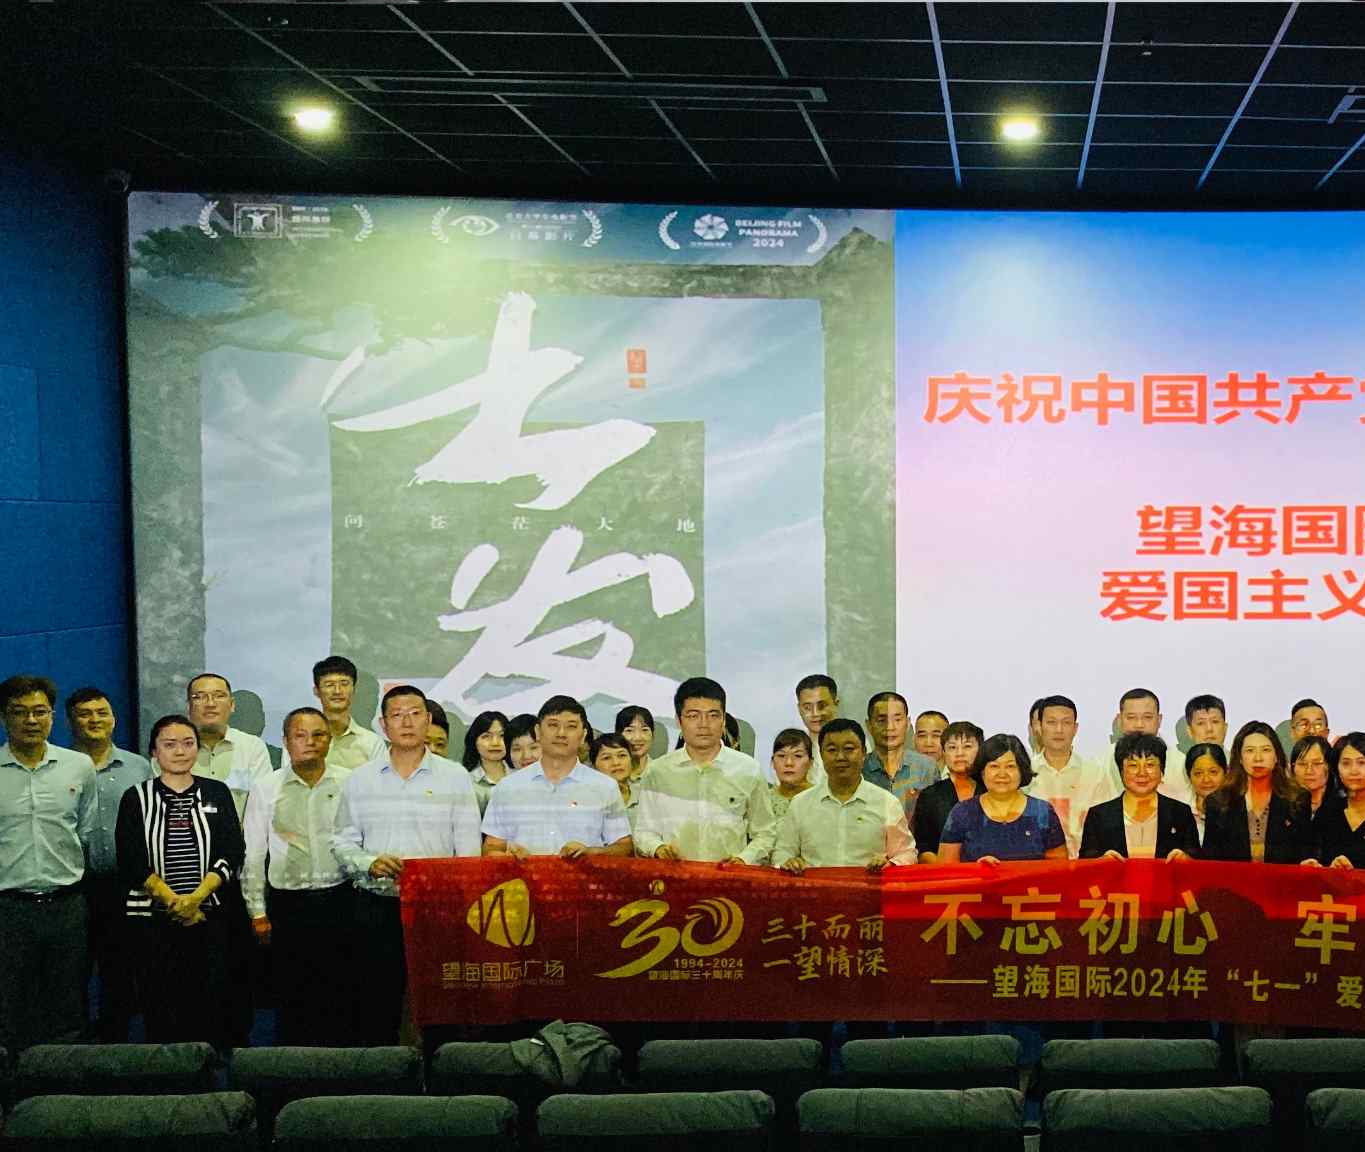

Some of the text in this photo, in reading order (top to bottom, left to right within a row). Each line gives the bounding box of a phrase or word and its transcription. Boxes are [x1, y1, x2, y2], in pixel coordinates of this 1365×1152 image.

[738, 228, 799, 237] PANORAMA
[778, 220, 802, 228] FILM
[752, 238, 785, 247] 2024
[761, 914, 886, 946] 三十而丽
[921, 885, 1218, 956] 不忘初心
[761, 945, 889, 981] 一望情深
